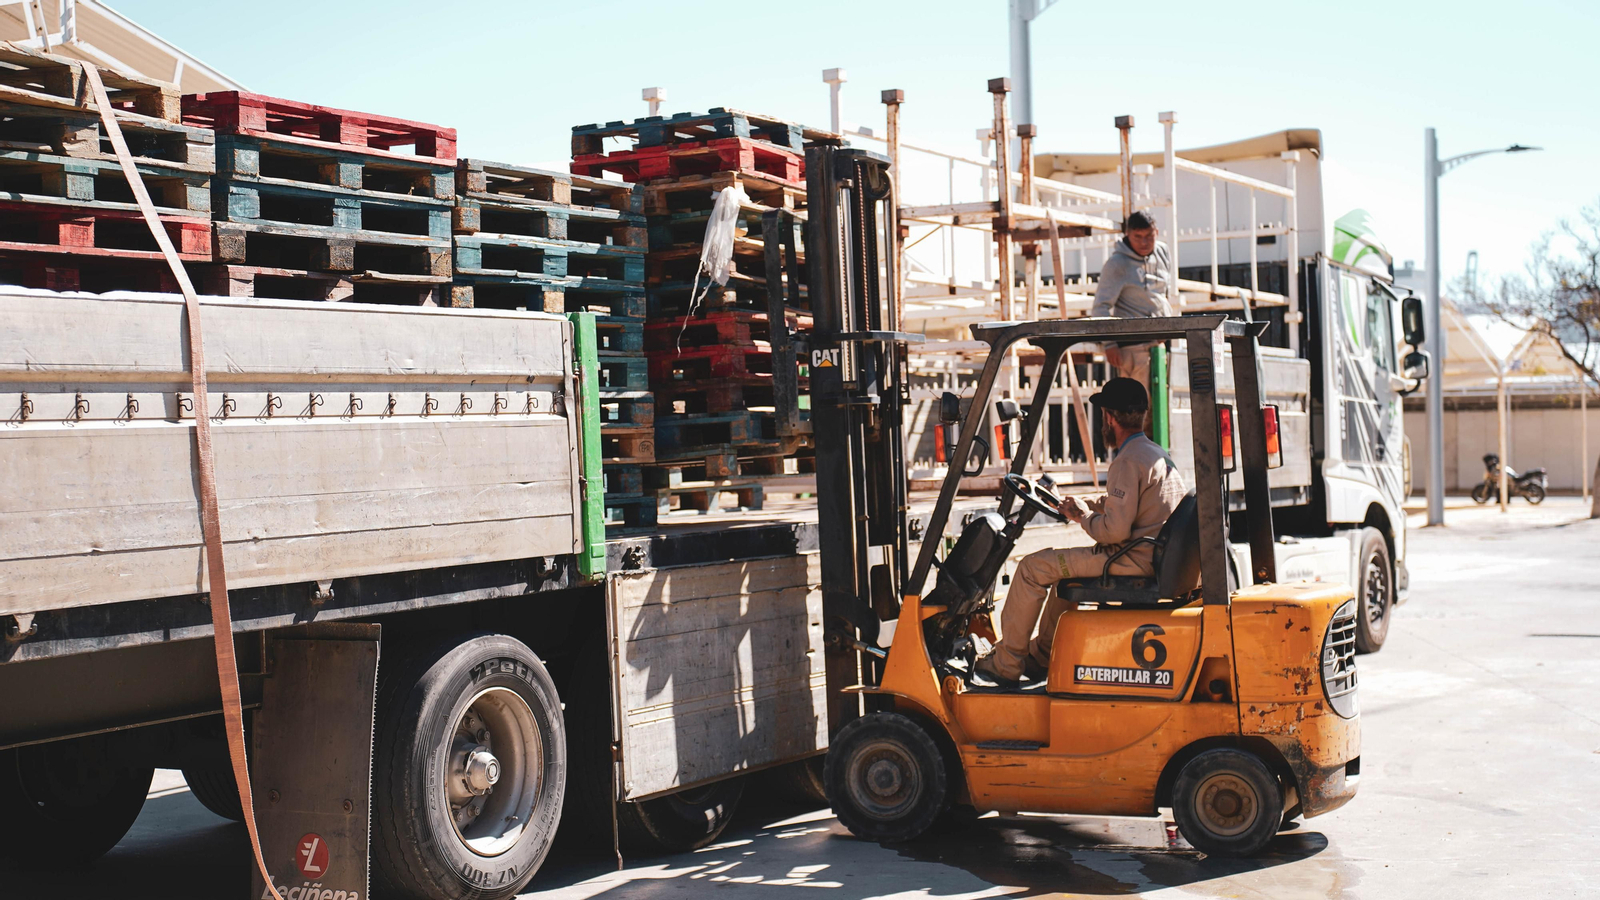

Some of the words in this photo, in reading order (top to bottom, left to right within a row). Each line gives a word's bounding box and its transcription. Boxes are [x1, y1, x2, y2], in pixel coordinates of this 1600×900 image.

[812, 348, 839, 368] CAT
[1131, 623, 1167, 669] 6
[1077, 667, 1150, 683] CATERPILLAR
[1155, 671, 1170, 685] 20
[460, 862, 493, 888] 300
[496, 864, 519, 885] NZ
